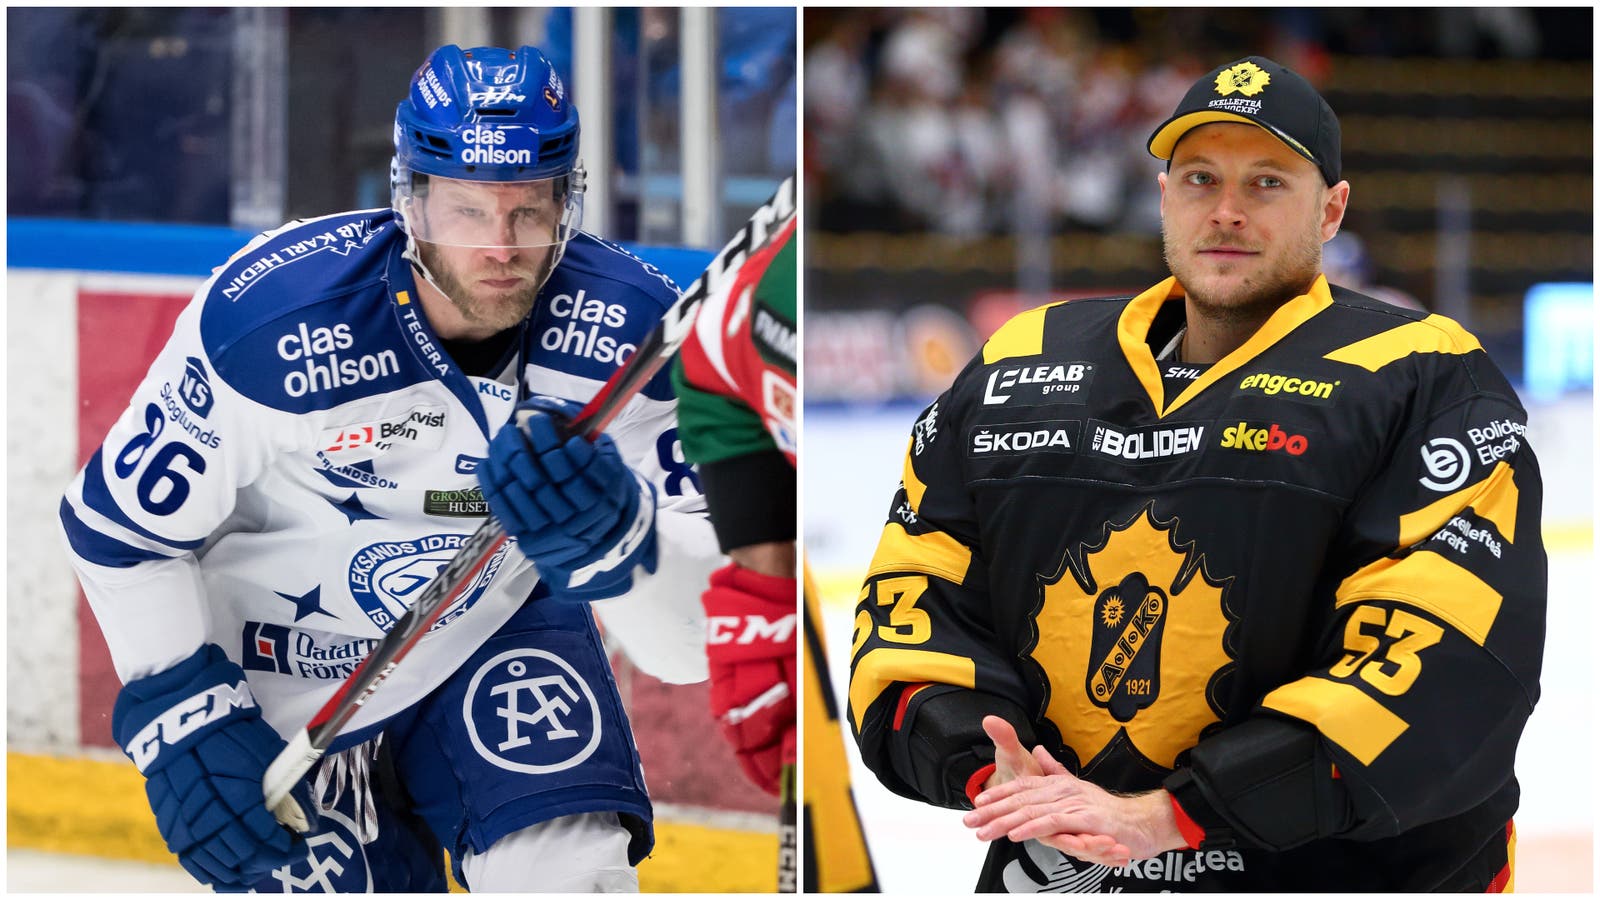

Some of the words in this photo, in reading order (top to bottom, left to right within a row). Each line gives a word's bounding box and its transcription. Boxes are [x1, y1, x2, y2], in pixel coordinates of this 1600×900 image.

[462, 126, 506, 145] clas
[461, 145, 531, 164] ohlson
[281, 231, 337, 258] KARL
[222, 253, 284, 299] HEDIN
[550, 289, 628, 328] clas
[277, 322, 354, 361] clas
[403, 308, 450, 377] TEGERA
[284, 349, 400, 398] ohlson
[1042, 383, 1080, 395] group
[1165, 367, 1201, 380] SHL
[1240, 373, 1333, 400] engcon
[479, 382, 512, 401] KLC
[160, 382, 221, 449] Skoglunds
[973, 430, 1071, 453] ŠKODA
[1092, 426, 1105, 451] NEW
[1100, 426, 1204, 460] BOLIDEN
[1220, 422, 1308, 456] skebo
[115, 402, 206, 516] 86
[351, 542, 418, 593] LEKSANDS
[707, 614, 797, 645] CM
[1329, 605, 1445, 696] 53
[1125, 679, 1151, 695] 1921
[125, 680, 255, 773] CCM
